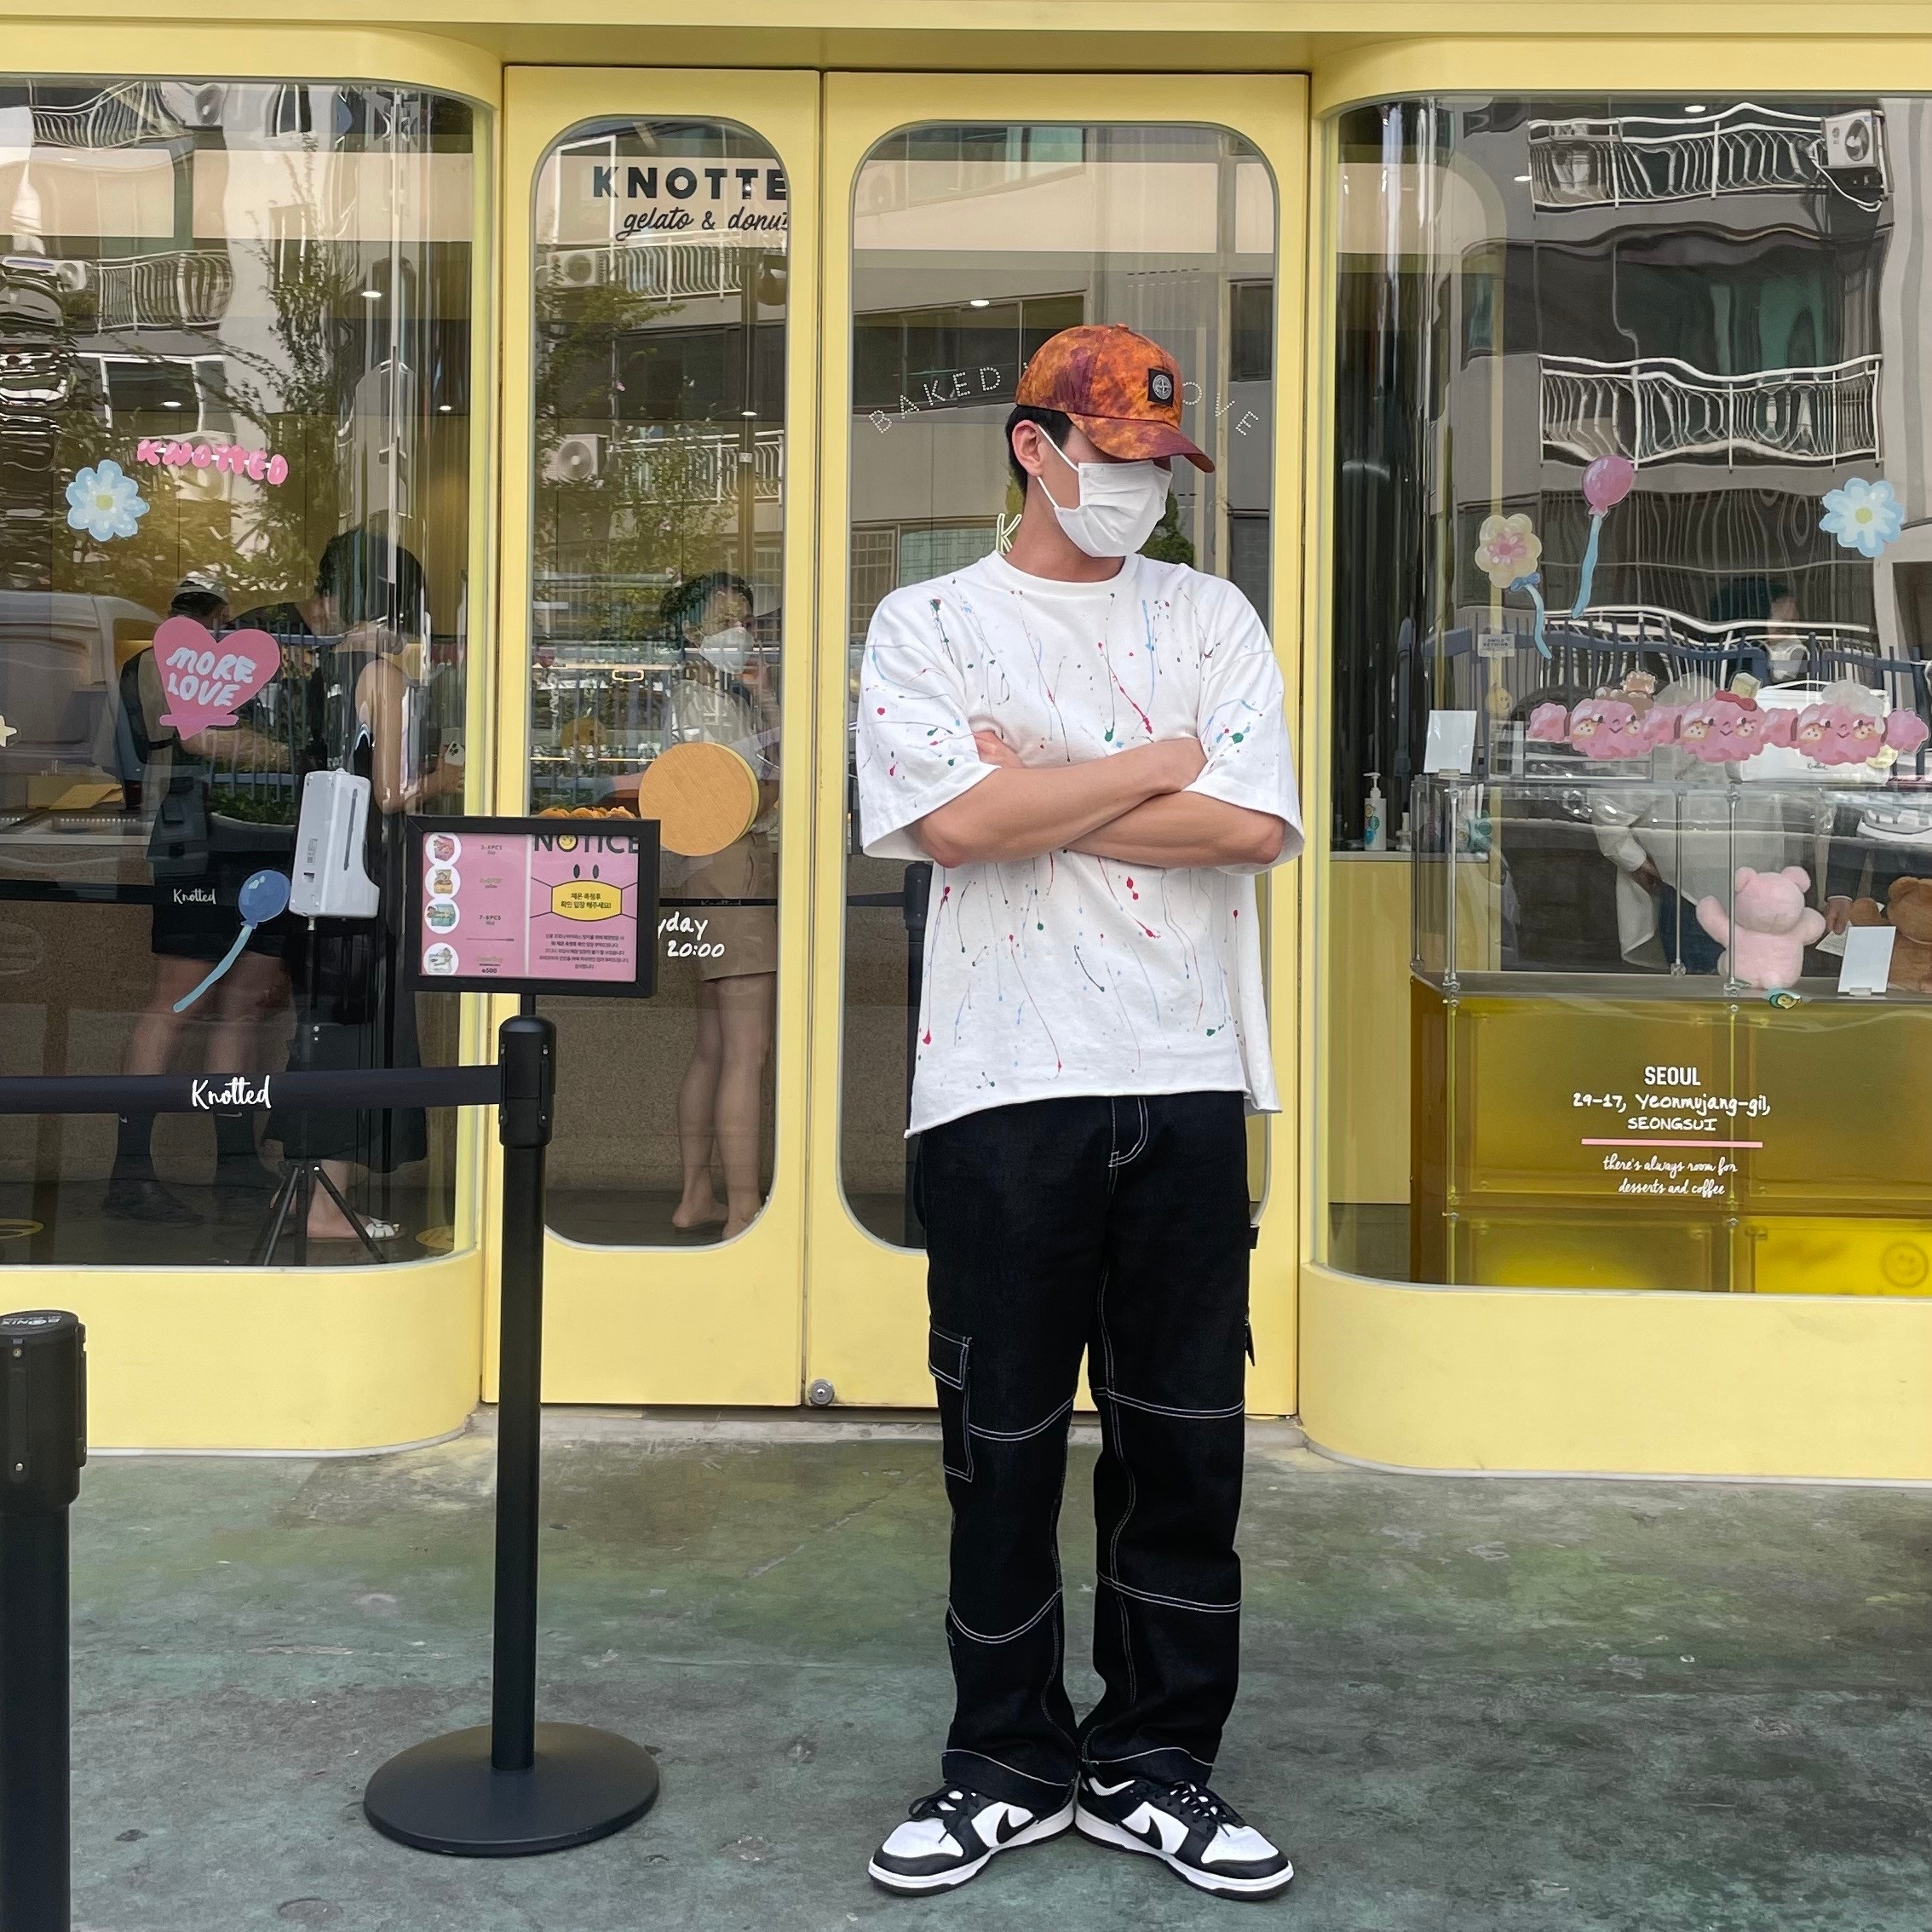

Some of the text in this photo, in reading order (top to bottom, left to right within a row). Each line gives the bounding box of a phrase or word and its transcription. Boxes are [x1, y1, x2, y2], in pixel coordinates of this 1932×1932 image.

[615, 206, 694, 242] gelato
[702, 210, 716, 230] &
[868, 366, 1002, 434] BAKED
[137, 439, 289, 486] KNOTTED
[165, 647, 258, 683] MORE
[167, 672, 241, 708] LOVE
[173, 888, 216, 905] Knotted
[667, 940, 726, 957] 20:00
[1644, 1066, 1701, 1086] SEOUL
[192, 1074, 272, 1110] Knotted
[1573, 1092, 1771, 1118] 29-17, Yeonmujang-gil,
[1603, 1153, 1739, 1179] there's always room for
[1619, 1177, 1726, 1199] desserts and coffee
